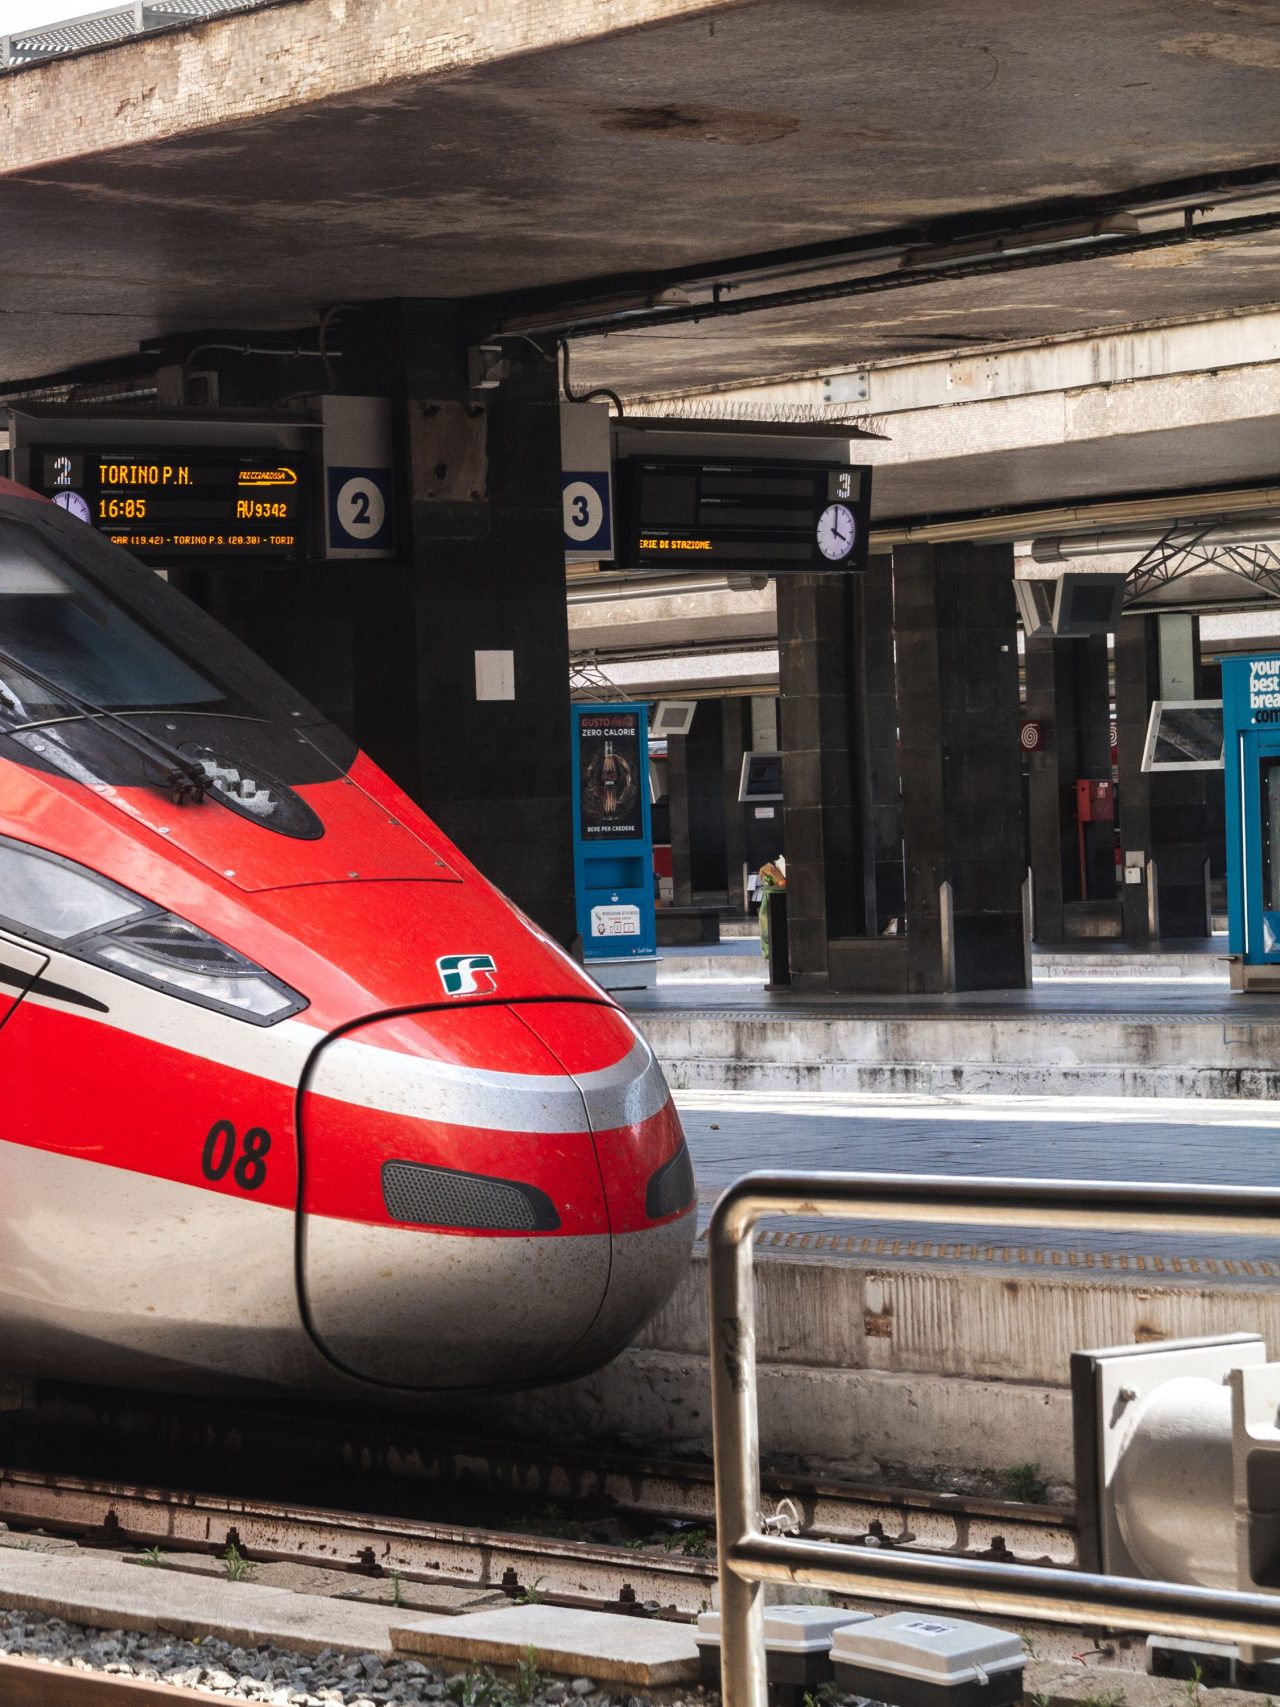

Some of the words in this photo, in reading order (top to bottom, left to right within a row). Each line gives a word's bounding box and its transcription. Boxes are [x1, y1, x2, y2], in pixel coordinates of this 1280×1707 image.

[53, 456, 72, 485] 2
[99, 465, 158, 484] TORINO
[163, 465, 193, 485] P.N.
[239, 471, 287, 480] FRECCIAROSSA
[836, 473, 851, 499] 3
[99, 499, 146, 518] 16:05
[350, 490, 371, 525] 2
[571, 495, 590, 528] 3
[131, 536, 164, 545] (19.42)
[173, 536, 207, 545] TORINO
[228, 536, 261, 545] (20.30)
[659, 540, 669, 549] DI
[671, 540, 713, 550] STAZIONE.
[1249, 660, 1280, 676] your
[1250, 676, 1280, 692] best
[582, 729, 602, 737] ZERO
[604, 728, 636, 736] CALORIE
[201, 1119, 272, 1191] 08
